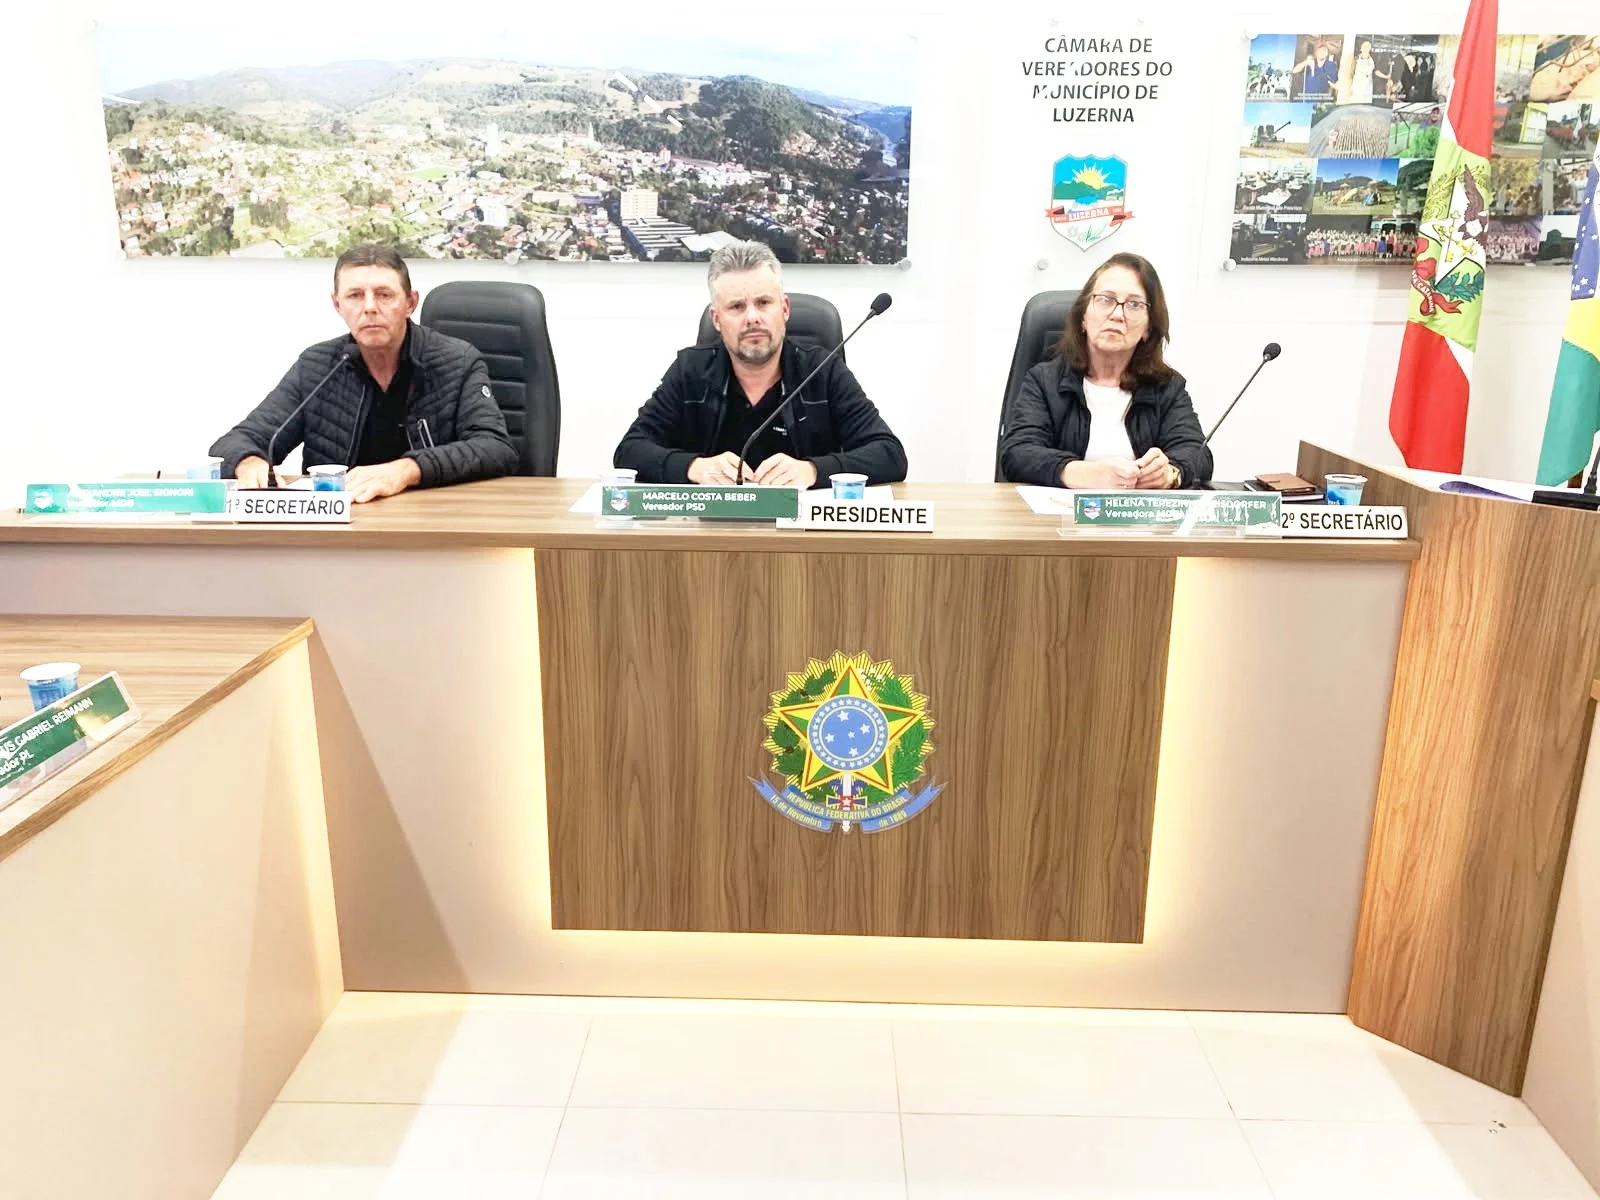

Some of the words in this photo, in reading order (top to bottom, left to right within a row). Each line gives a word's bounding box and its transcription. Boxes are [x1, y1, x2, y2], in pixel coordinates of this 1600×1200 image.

[1044, 34, 1123, 53] CÂMARA
[1130, 38, 1153, 53] DE
[1146, 61, 1173, 76] DO
[1135, 85, 1158, 99] DE
[1053, 107, 1135, 122] LUZERNA
[1068, 208, 1110, 221] LUZERNA
[642, 491, 690, 501] MARCELO
[691, 492, 723, 501] COSTA
[724, 492, 757, 502] BEBER
[1105, 498, 1144, 508] HELENA
[244, 495, 345, 515] SECRETÁRIO
[642, 502, 684, 512] Vereador
[685, 502, 706, 512] PSD
[811, 504, 928, 524] PRESIDENTE
[1105, 508, 1155, 519] Vereadora
[1281, 512, 1295, 529] 2º
[1300, 508, 1403, 531] SECRETÁRIO
[14, 719, 55, 746] GABRIEL
[52, 696, 94, 725] REIMANN
[786, 806, 823, 828] Novembro
[826, 808, 870, 820] FEDERATIVA
